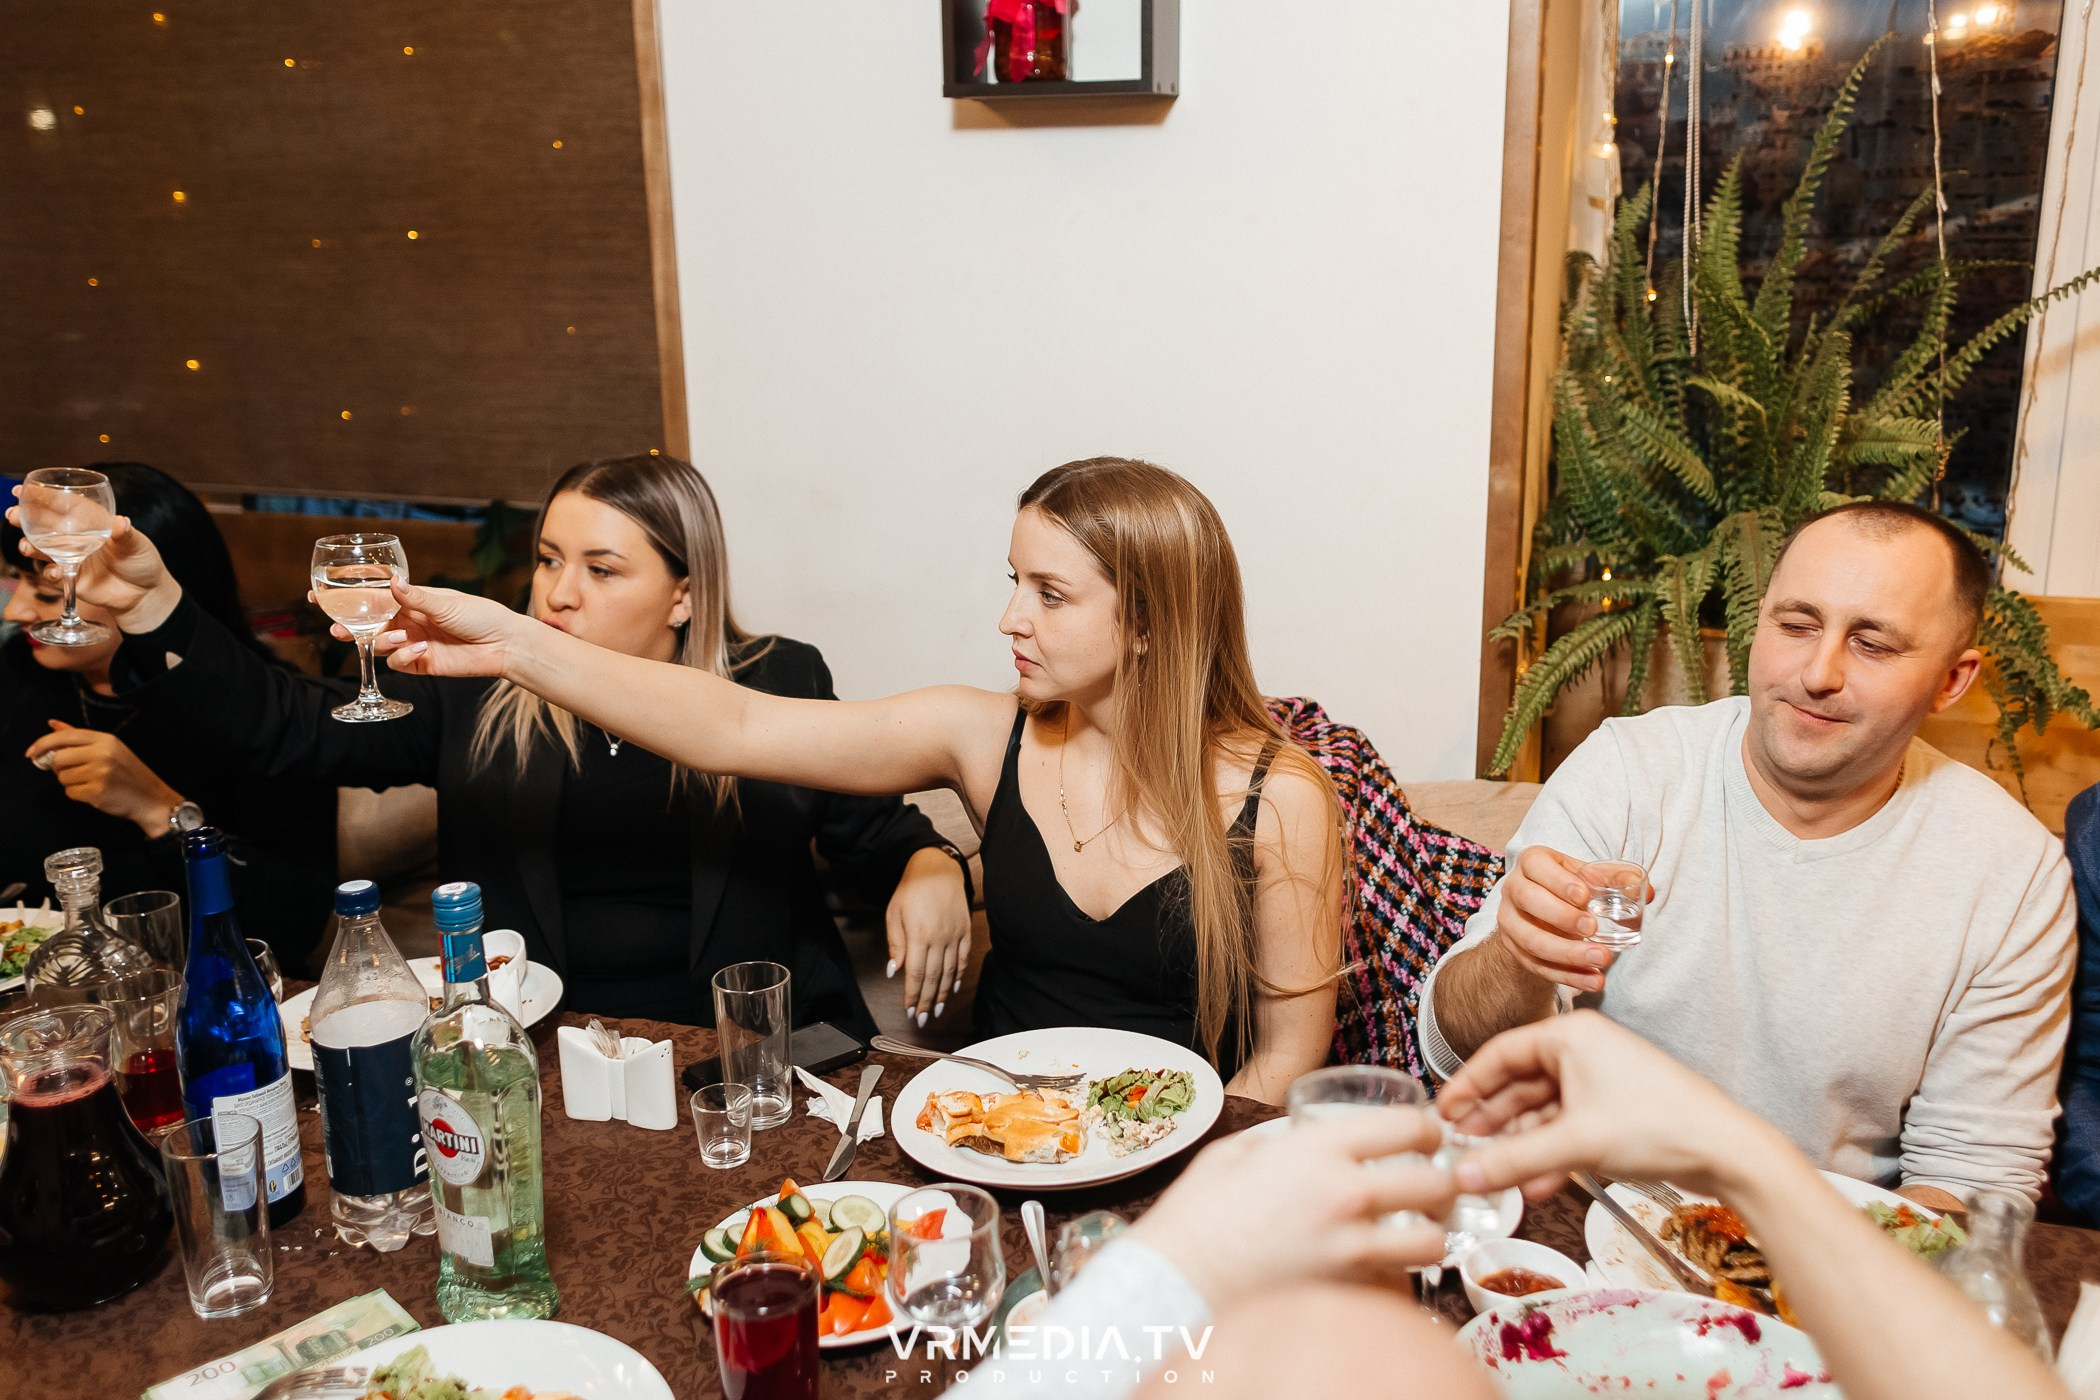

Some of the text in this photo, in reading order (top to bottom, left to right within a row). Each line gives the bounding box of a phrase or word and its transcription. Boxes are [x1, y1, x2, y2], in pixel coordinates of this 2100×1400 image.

[422, 1118, 479, 1153] MARTINI
[438, 1206, 474, 1228] BIANCO
[366, 1328, 394, 1347] 200
[186, 1361, 237, 1387] 200
